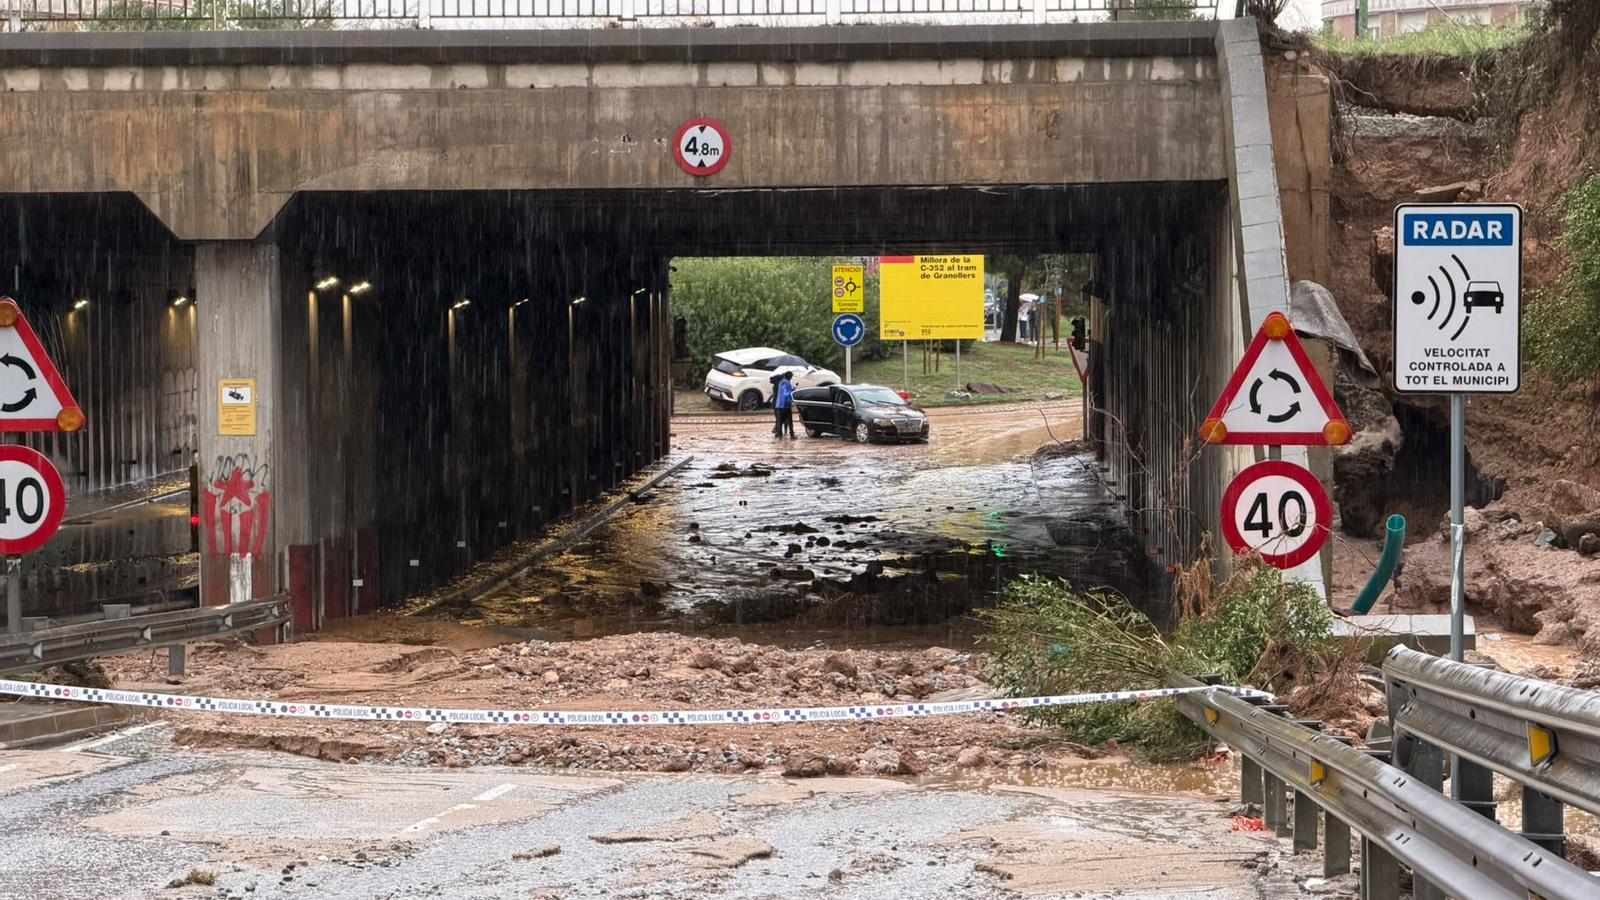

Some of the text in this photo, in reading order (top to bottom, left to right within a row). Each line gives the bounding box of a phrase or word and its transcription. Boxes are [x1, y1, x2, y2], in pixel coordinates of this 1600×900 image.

[1413, 220, 1503, 240] RADAR
[920, 256, 971, 264] Millora de la
[1424, 348, 1491, 358] VELOCITAT
[1409, 361, 1506, 372] CONTROLADA A
[1405, 375, 1509, 385] TOT EL MUNICIPI
[1243, 490, 1307, 538] 40
[105, 693, 140, 703] POLICIA LOCAL
[219, 701, 254, 711] POLICIA LOCAL
[333, 708, 369, 717] POLICIA LOCAL
[449, 712, 486, 721] POLICIA LOCAL
[687, 713, 725, 721] POLICIA LOCAL
[809, 709, 848, 719] POLICIA LOCAL
[567, 714, 605, 722] POLICIA LOCAL
